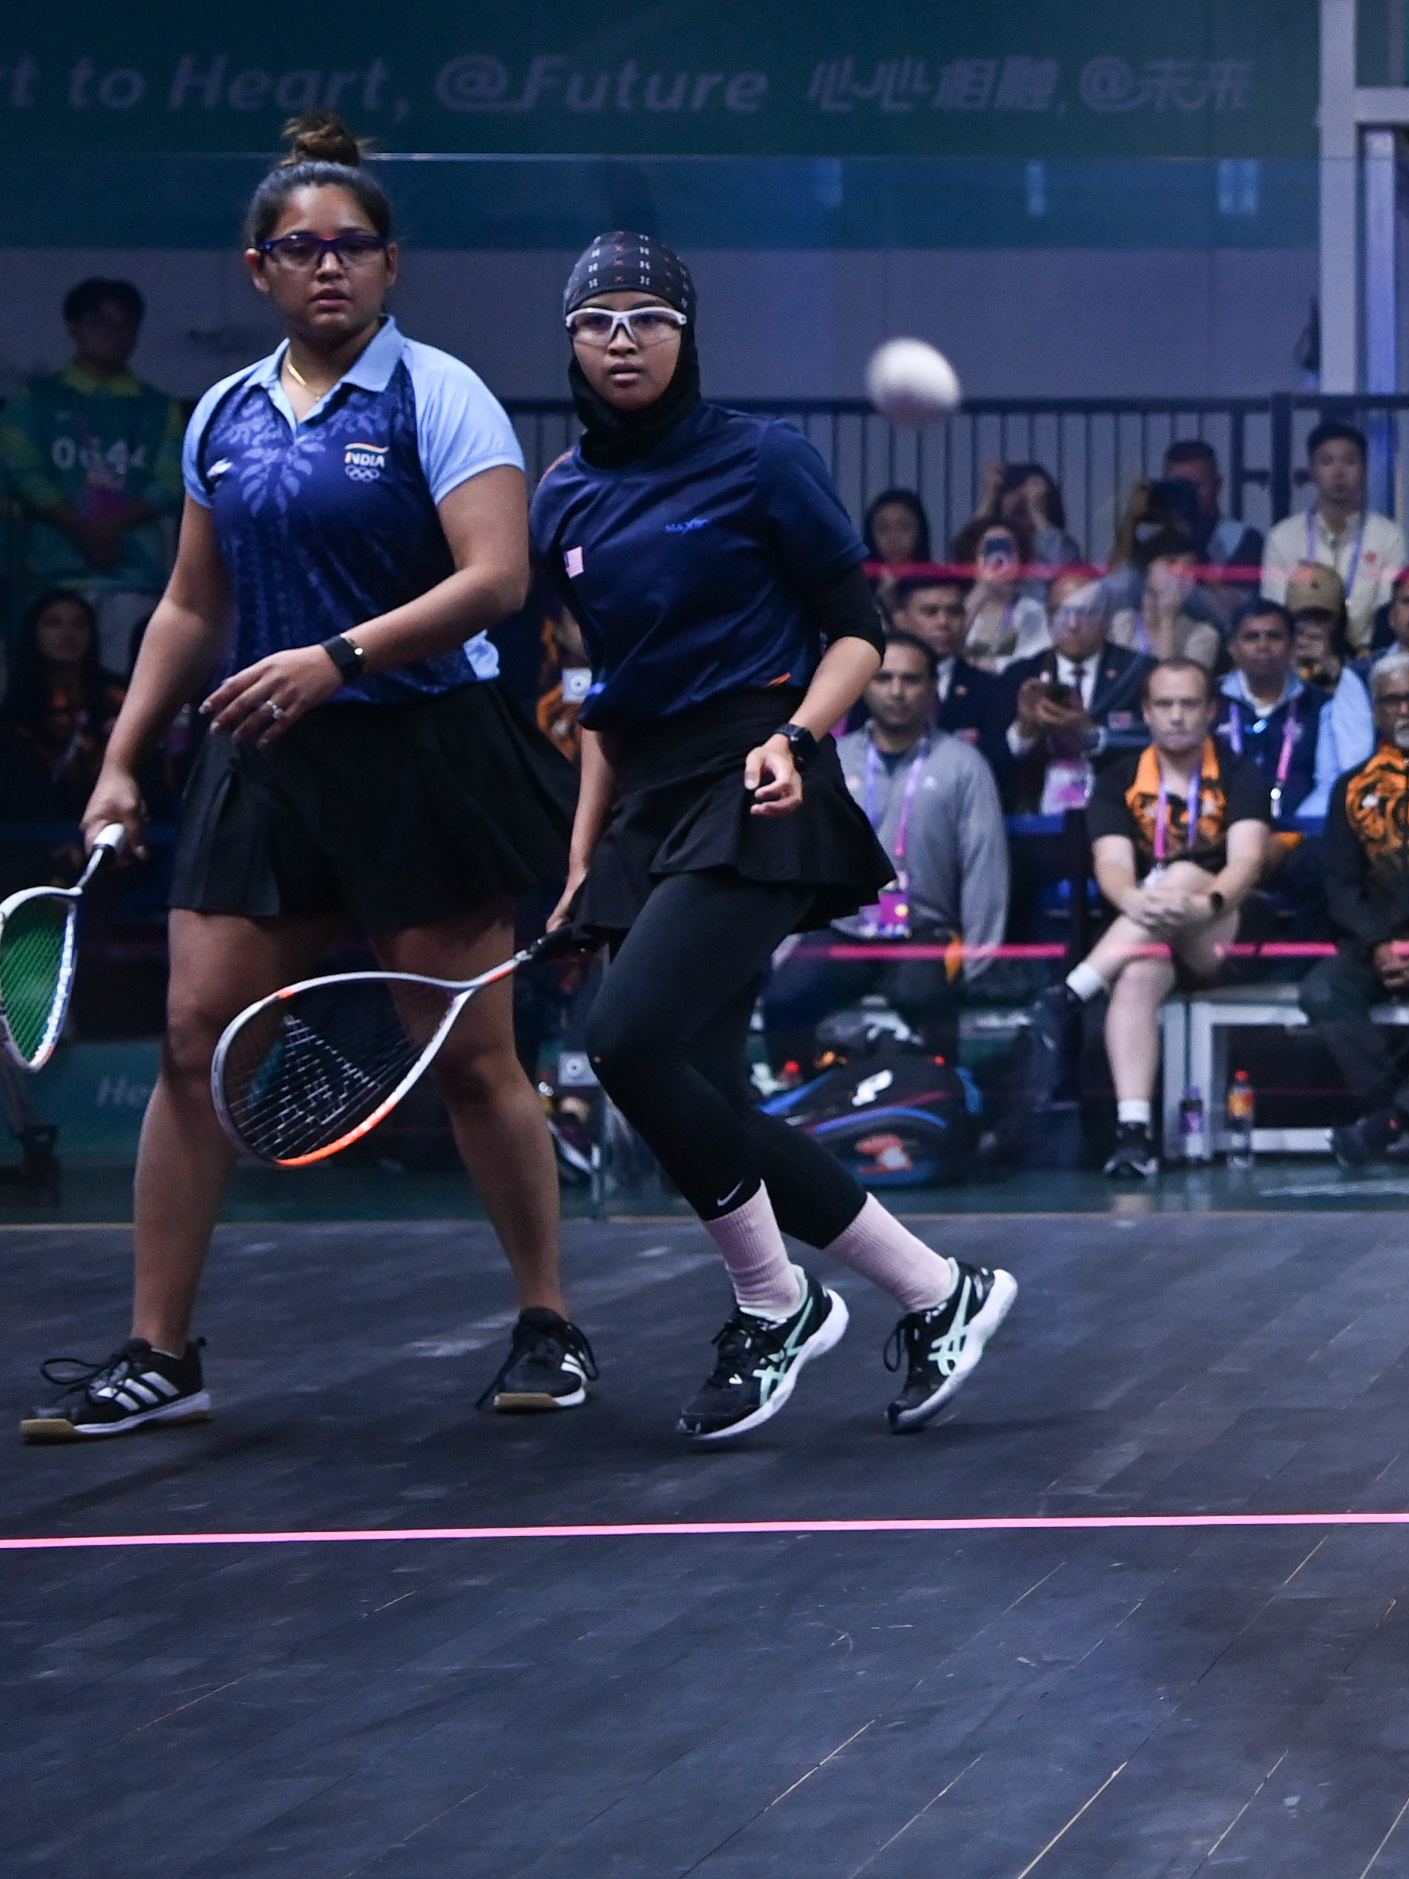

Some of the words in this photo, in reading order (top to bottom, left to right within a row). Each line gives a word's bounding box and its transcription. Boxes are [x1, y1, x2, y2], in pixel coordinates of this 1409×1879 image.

[67, 54, 147, 109] to
[168, 53, 411, 121] Heart,
[435, 53, 770, 114] @Future
[344, 451, 386, 469] INDIA
